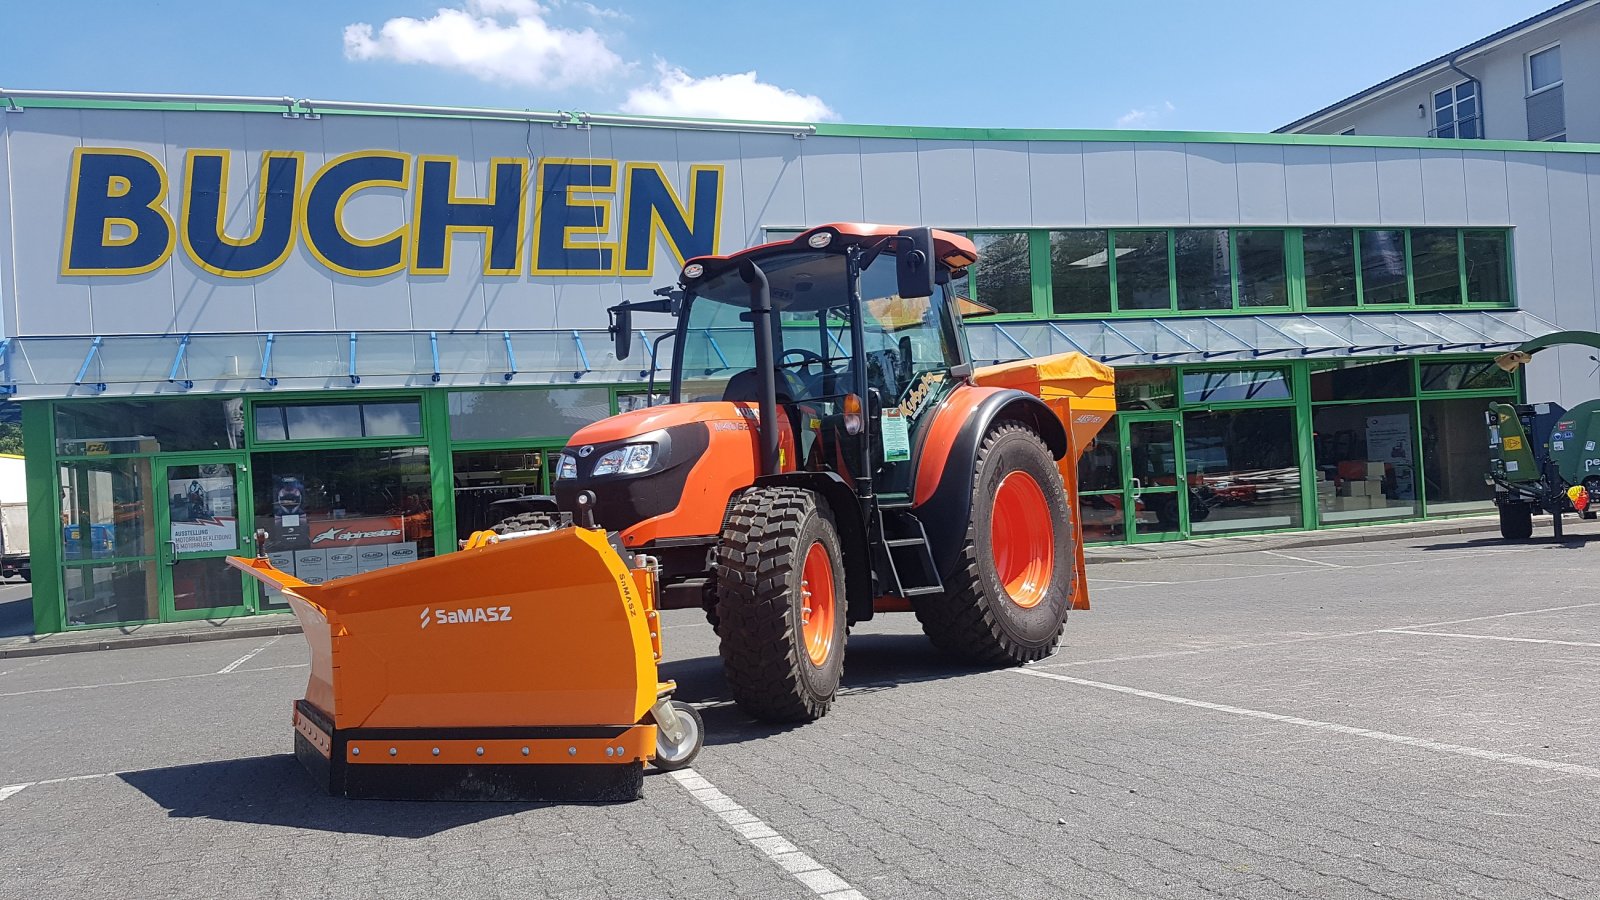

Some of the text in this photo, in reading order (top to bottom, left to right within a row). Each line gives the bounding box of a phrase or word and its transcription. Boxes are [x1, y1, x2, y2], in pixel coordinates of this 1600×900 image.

[61, 147, 724, 278] BUCHEN
[175, 529, 208, 537] AUSSTELLUNG
[338, 529, 401, 541] alpinestars
[619, 573, 637, 618] SaMASZ
[435, 606, 512, 625] SaMASZ
